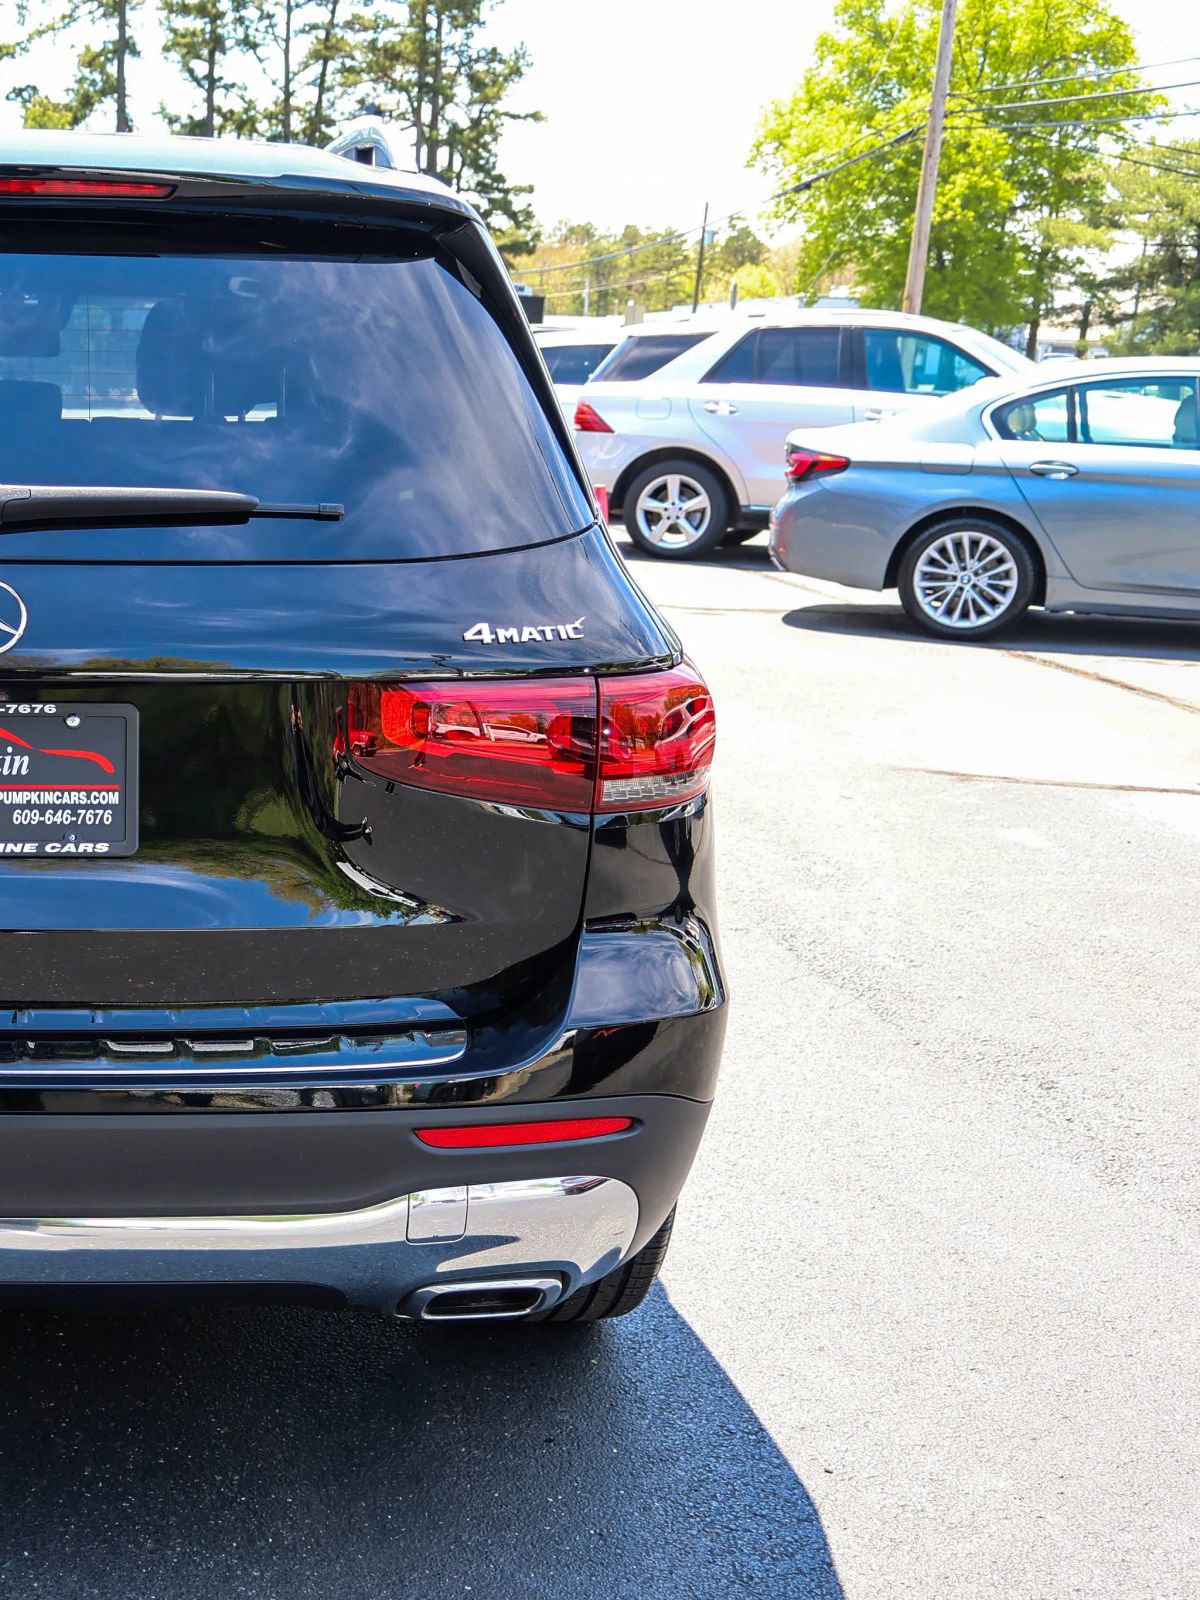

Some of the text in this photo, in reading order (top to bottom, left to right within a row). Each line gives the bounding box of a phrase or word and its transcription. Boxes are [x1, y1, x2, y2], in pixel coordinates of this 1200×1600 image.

[463, 616, 587, 645] 4MATIC
[12, 809, 113, 825] 609-646-7676
[44, 842, 110, 853] CARS
